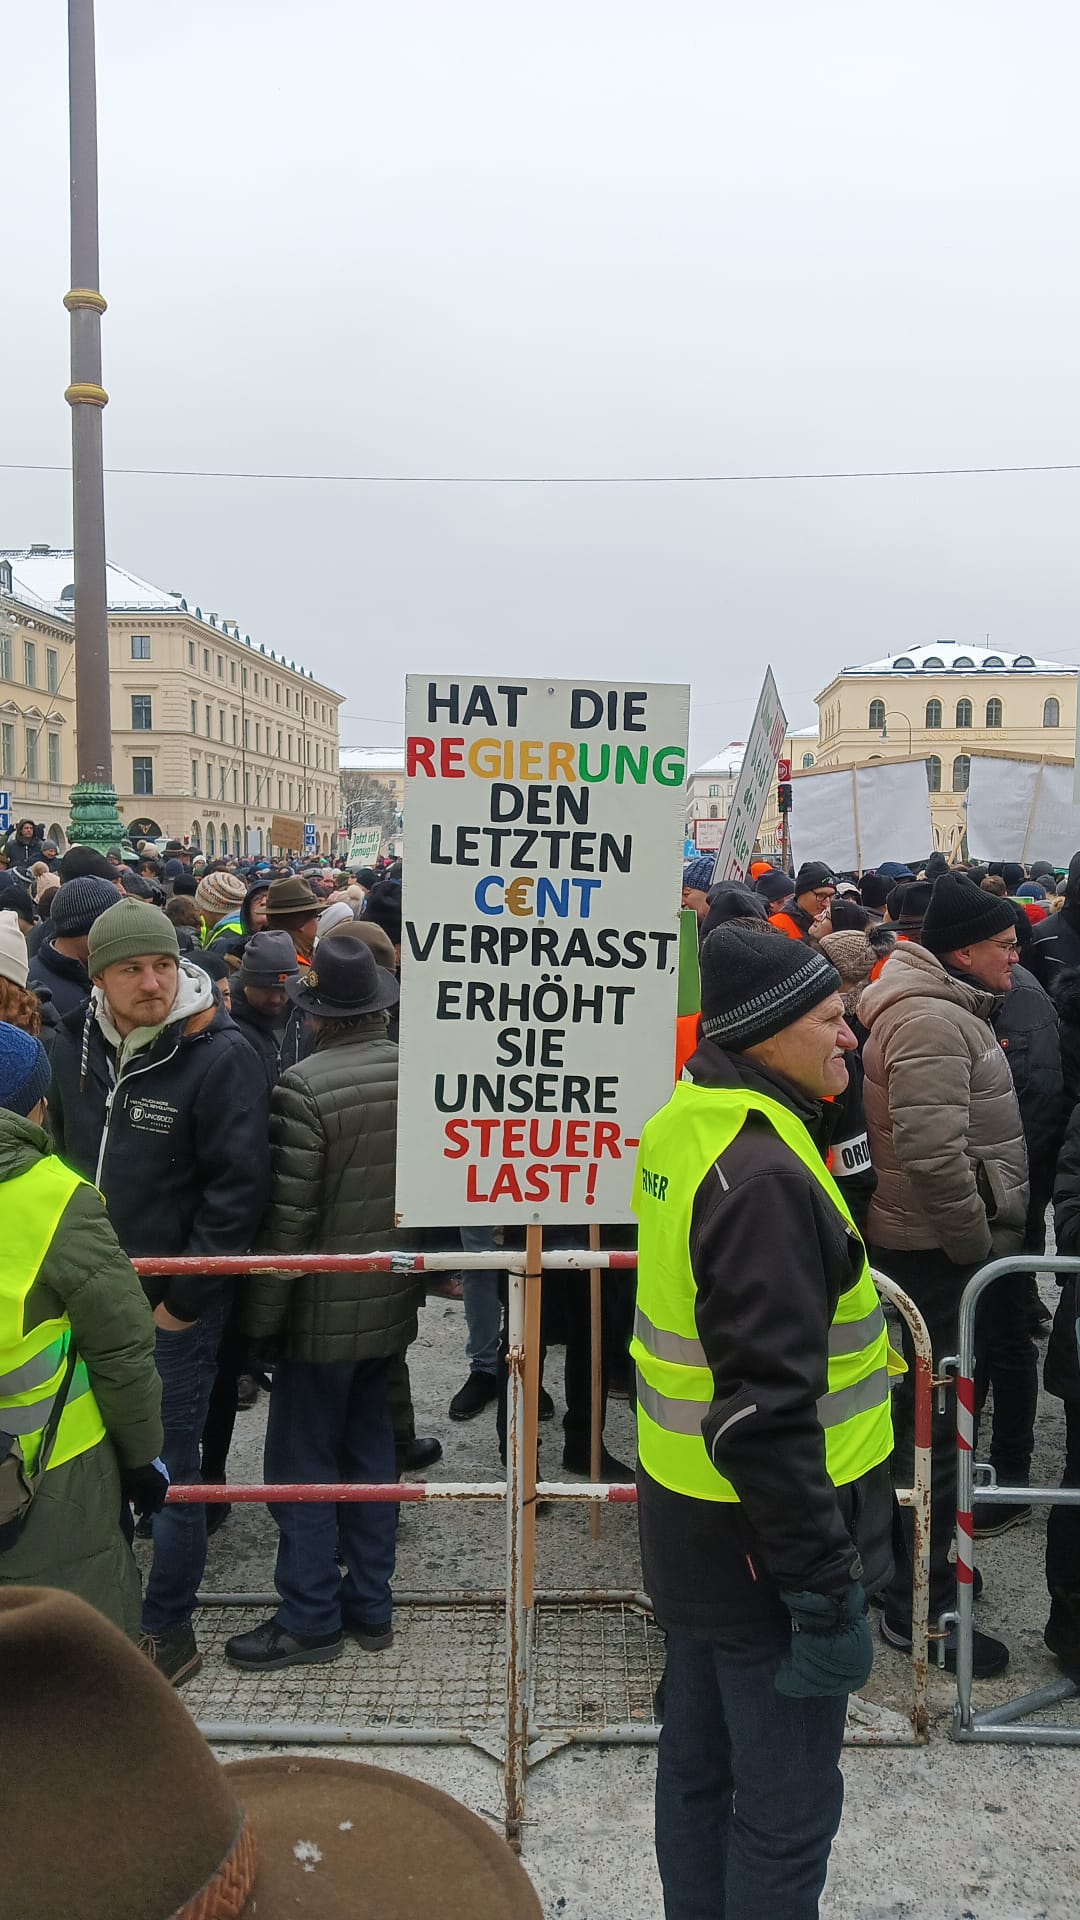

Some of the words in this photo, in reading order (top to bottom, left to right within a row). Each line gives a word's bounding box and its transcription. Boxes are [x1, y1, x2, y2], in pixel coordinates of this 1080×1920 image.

[428, 682, 527, 727] HAT
[570, 689, 648, 731] DIE
[769, 711, 785, 759] UNS
[406, 736, 686, 786] REGIERUNG
[750, 731, 771, 793] bleibt
[490, 782, 590, 825] DEN
[743, 778, 757, 822] dein
[307, 825, 314, 834] U
[351, 832, 367, 848] Jetzt
[430, 824, 632, 873] LETZTEN
[730, 805, 749, 864] Teller
[474, 875, 602, 918] C€NT
[405, 921, 678, 975] VERPRASST,
[436, 973, 636, 1025] ERHÖHT
[496, 1027, 566, 1067] SIE
[434, 1073, 619, 1113] UNSERE
[443, 1118, 640, 1159] STEUER-
[466, 1163, 598, 1205] LAST!
